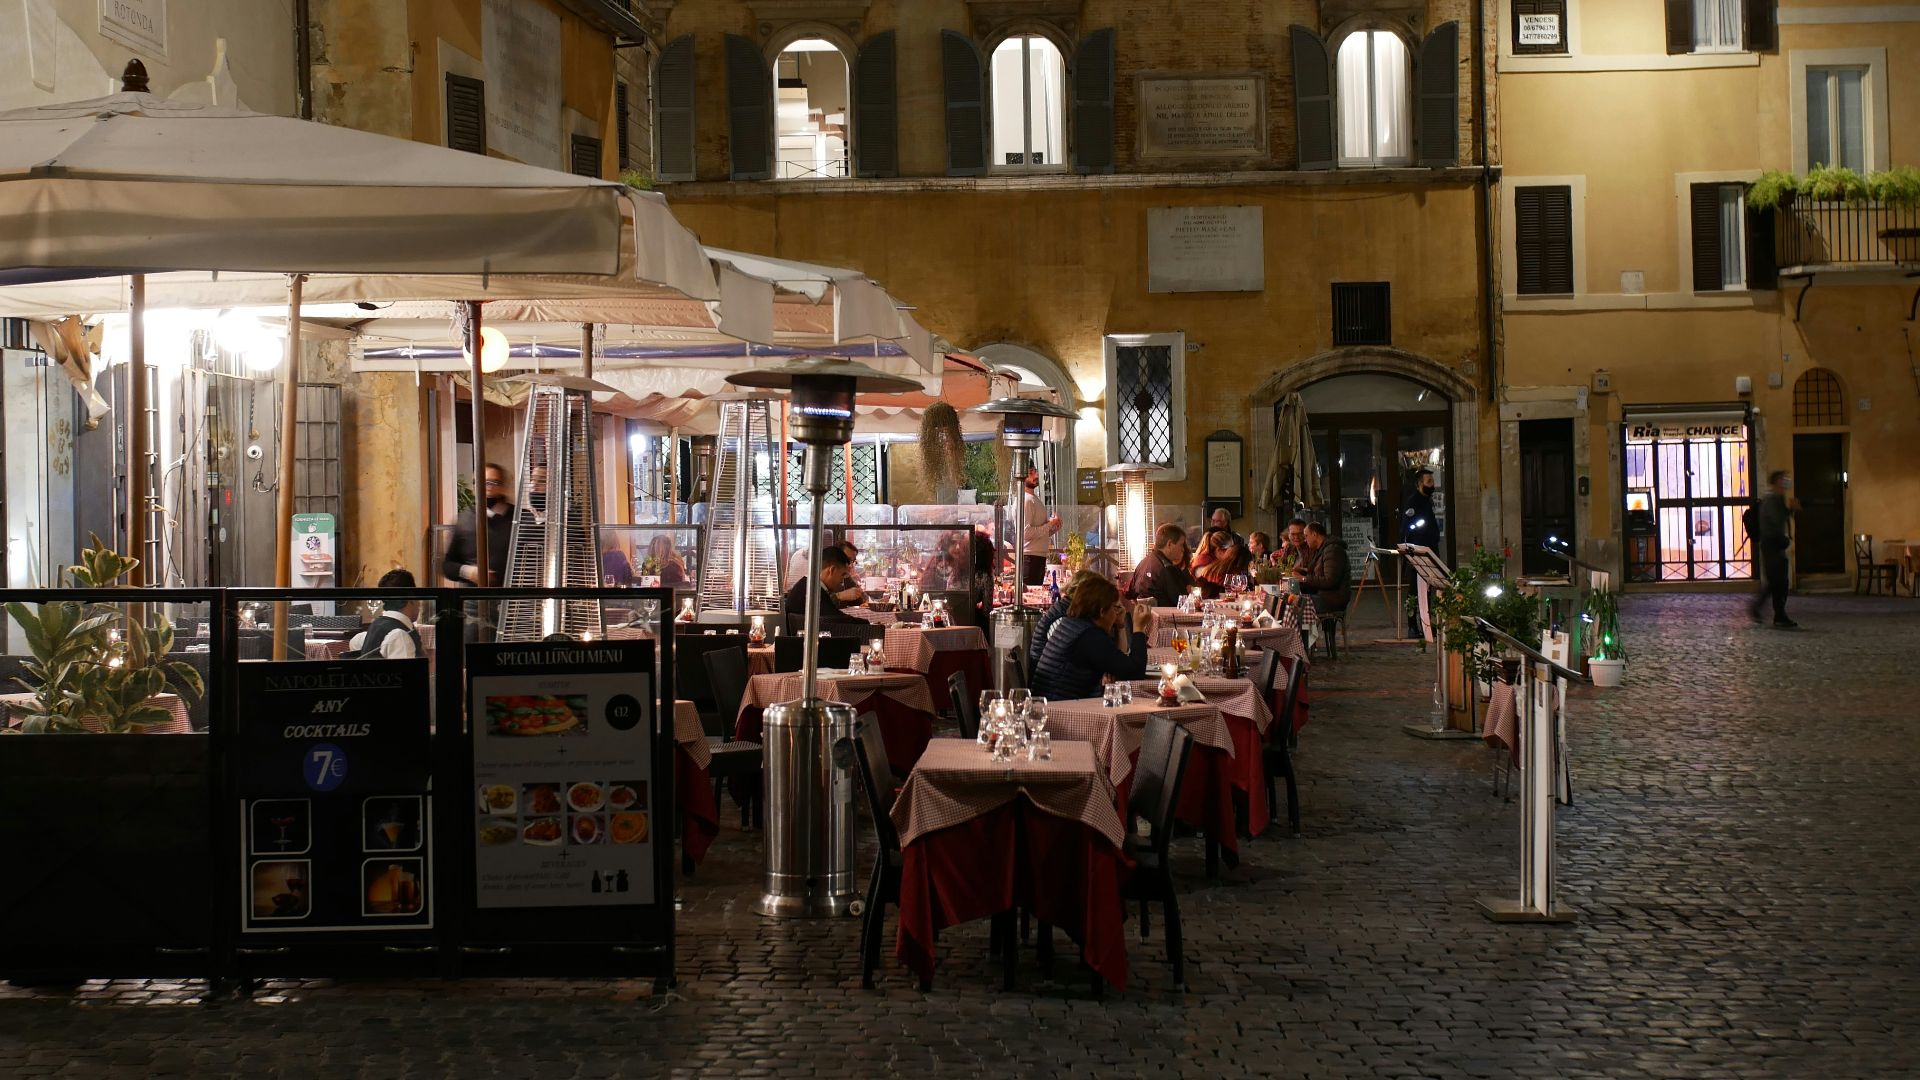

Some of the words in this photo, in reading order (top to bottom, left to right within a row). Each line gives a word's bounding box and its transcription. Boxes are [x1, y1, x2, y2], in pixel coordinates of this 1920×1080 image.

[114, 0, 154, 33] ROTONDA
[1633, 422, 1660, 437] Ria
[1686, 425, 1739, 436] CHANGE
[496, 651, 545, 666] SPECIAL
[545, 650, 584, 665] LUNCH
[587, 649, 623, 663] MENU
[264, 672, 403, 689] NAPOLETANO'S
[311, 697, 350, 713] ANY
[613, 706, 629, 718] €12
[283, 723, 371, 738] COCKTAILS
[313, 751, 343, 785] 7€
